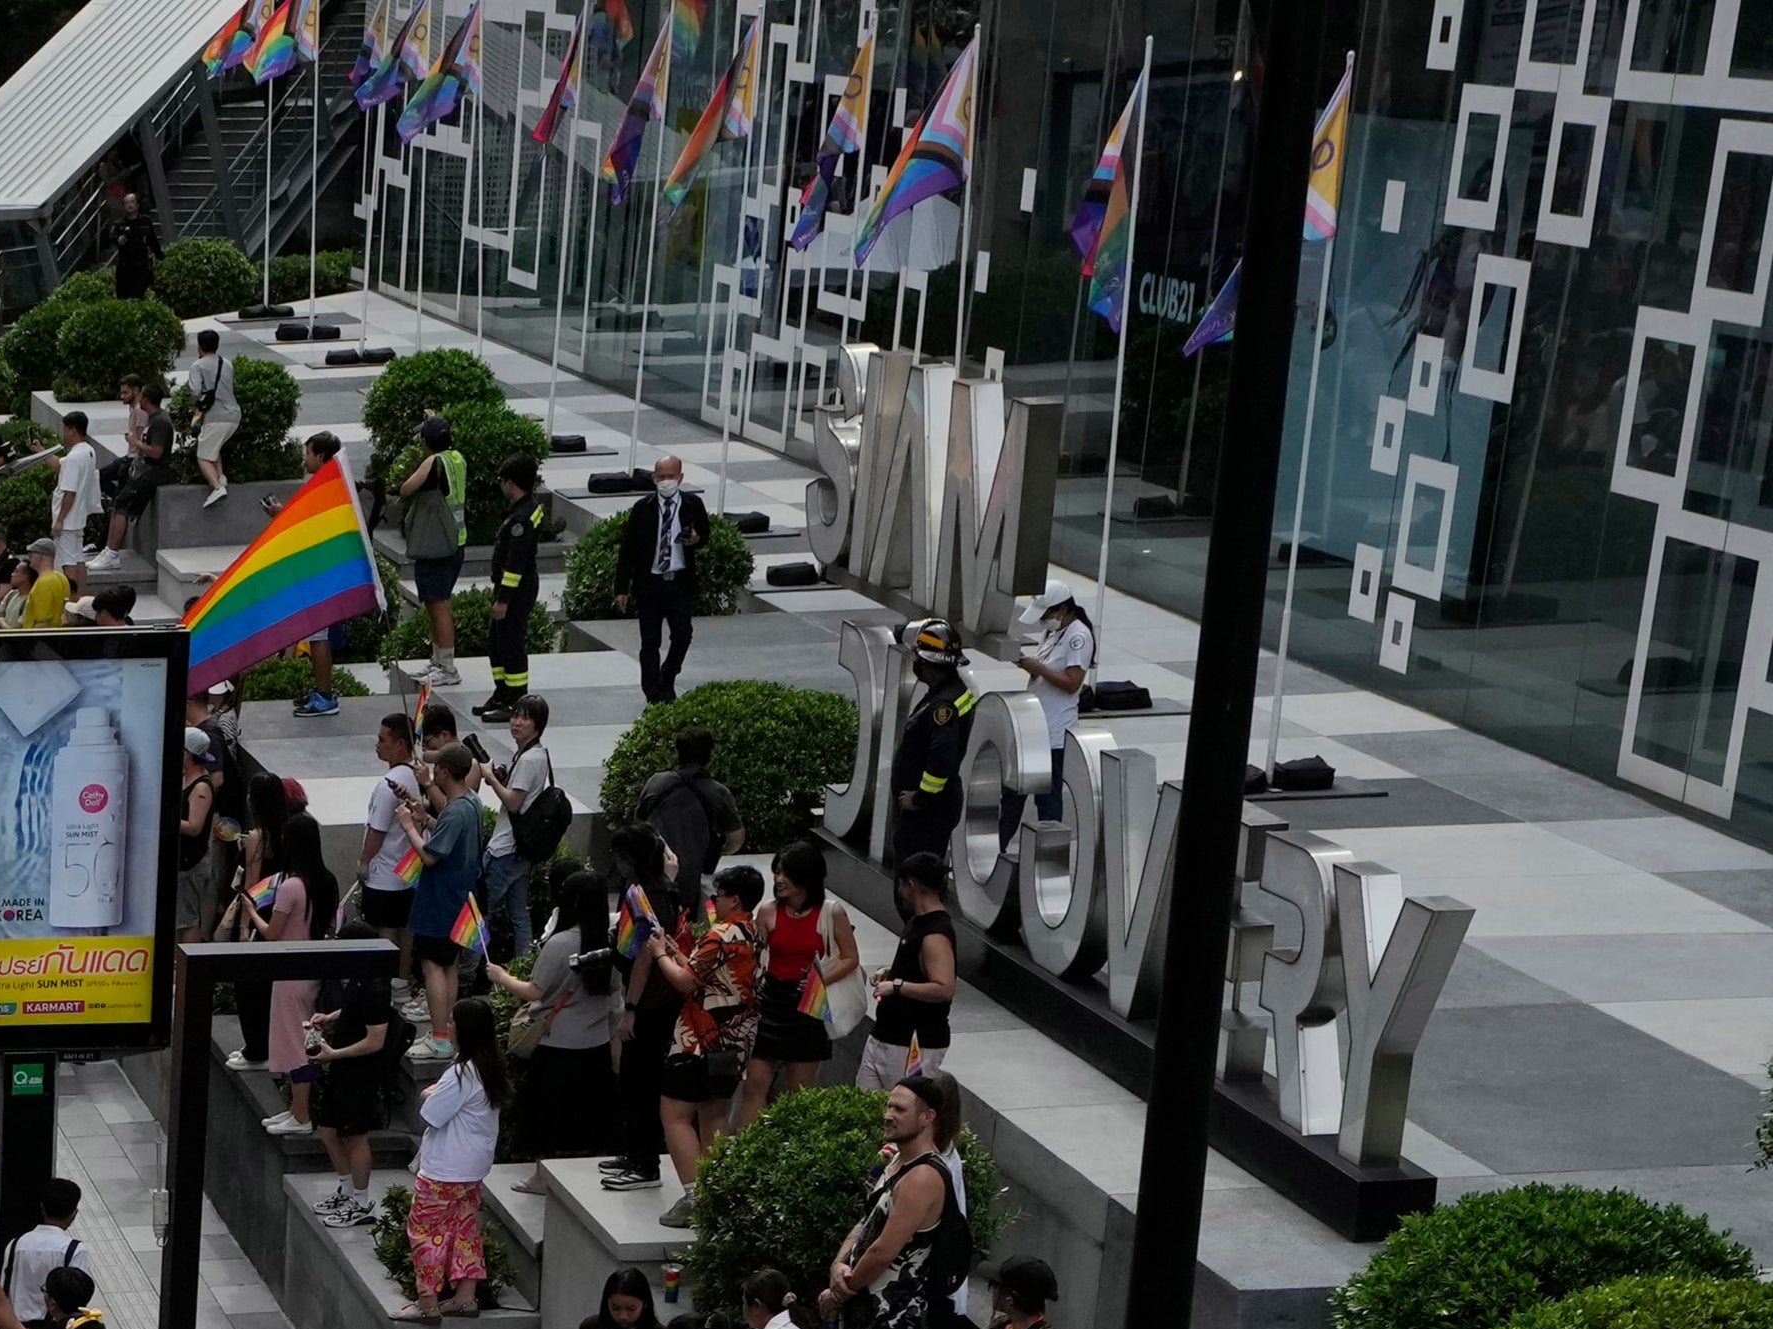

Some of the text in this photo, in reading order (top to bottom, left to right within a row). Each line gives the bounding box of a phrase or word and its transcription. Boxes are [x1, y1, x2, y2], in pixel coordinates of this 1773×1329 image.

[805, 341, 1065, 637] SIAM
[82, 790, 105, 803] Cathy
[65, 830, 99, 839] SUN MIST
[2, 897, 45, 907] MADE IN
[12, 979, 36, 991] Light
[37, 979, 58, 988] SUN
[60, 978, 84, 988] MIST
[25, 1001, 82, 1013] KARMART
